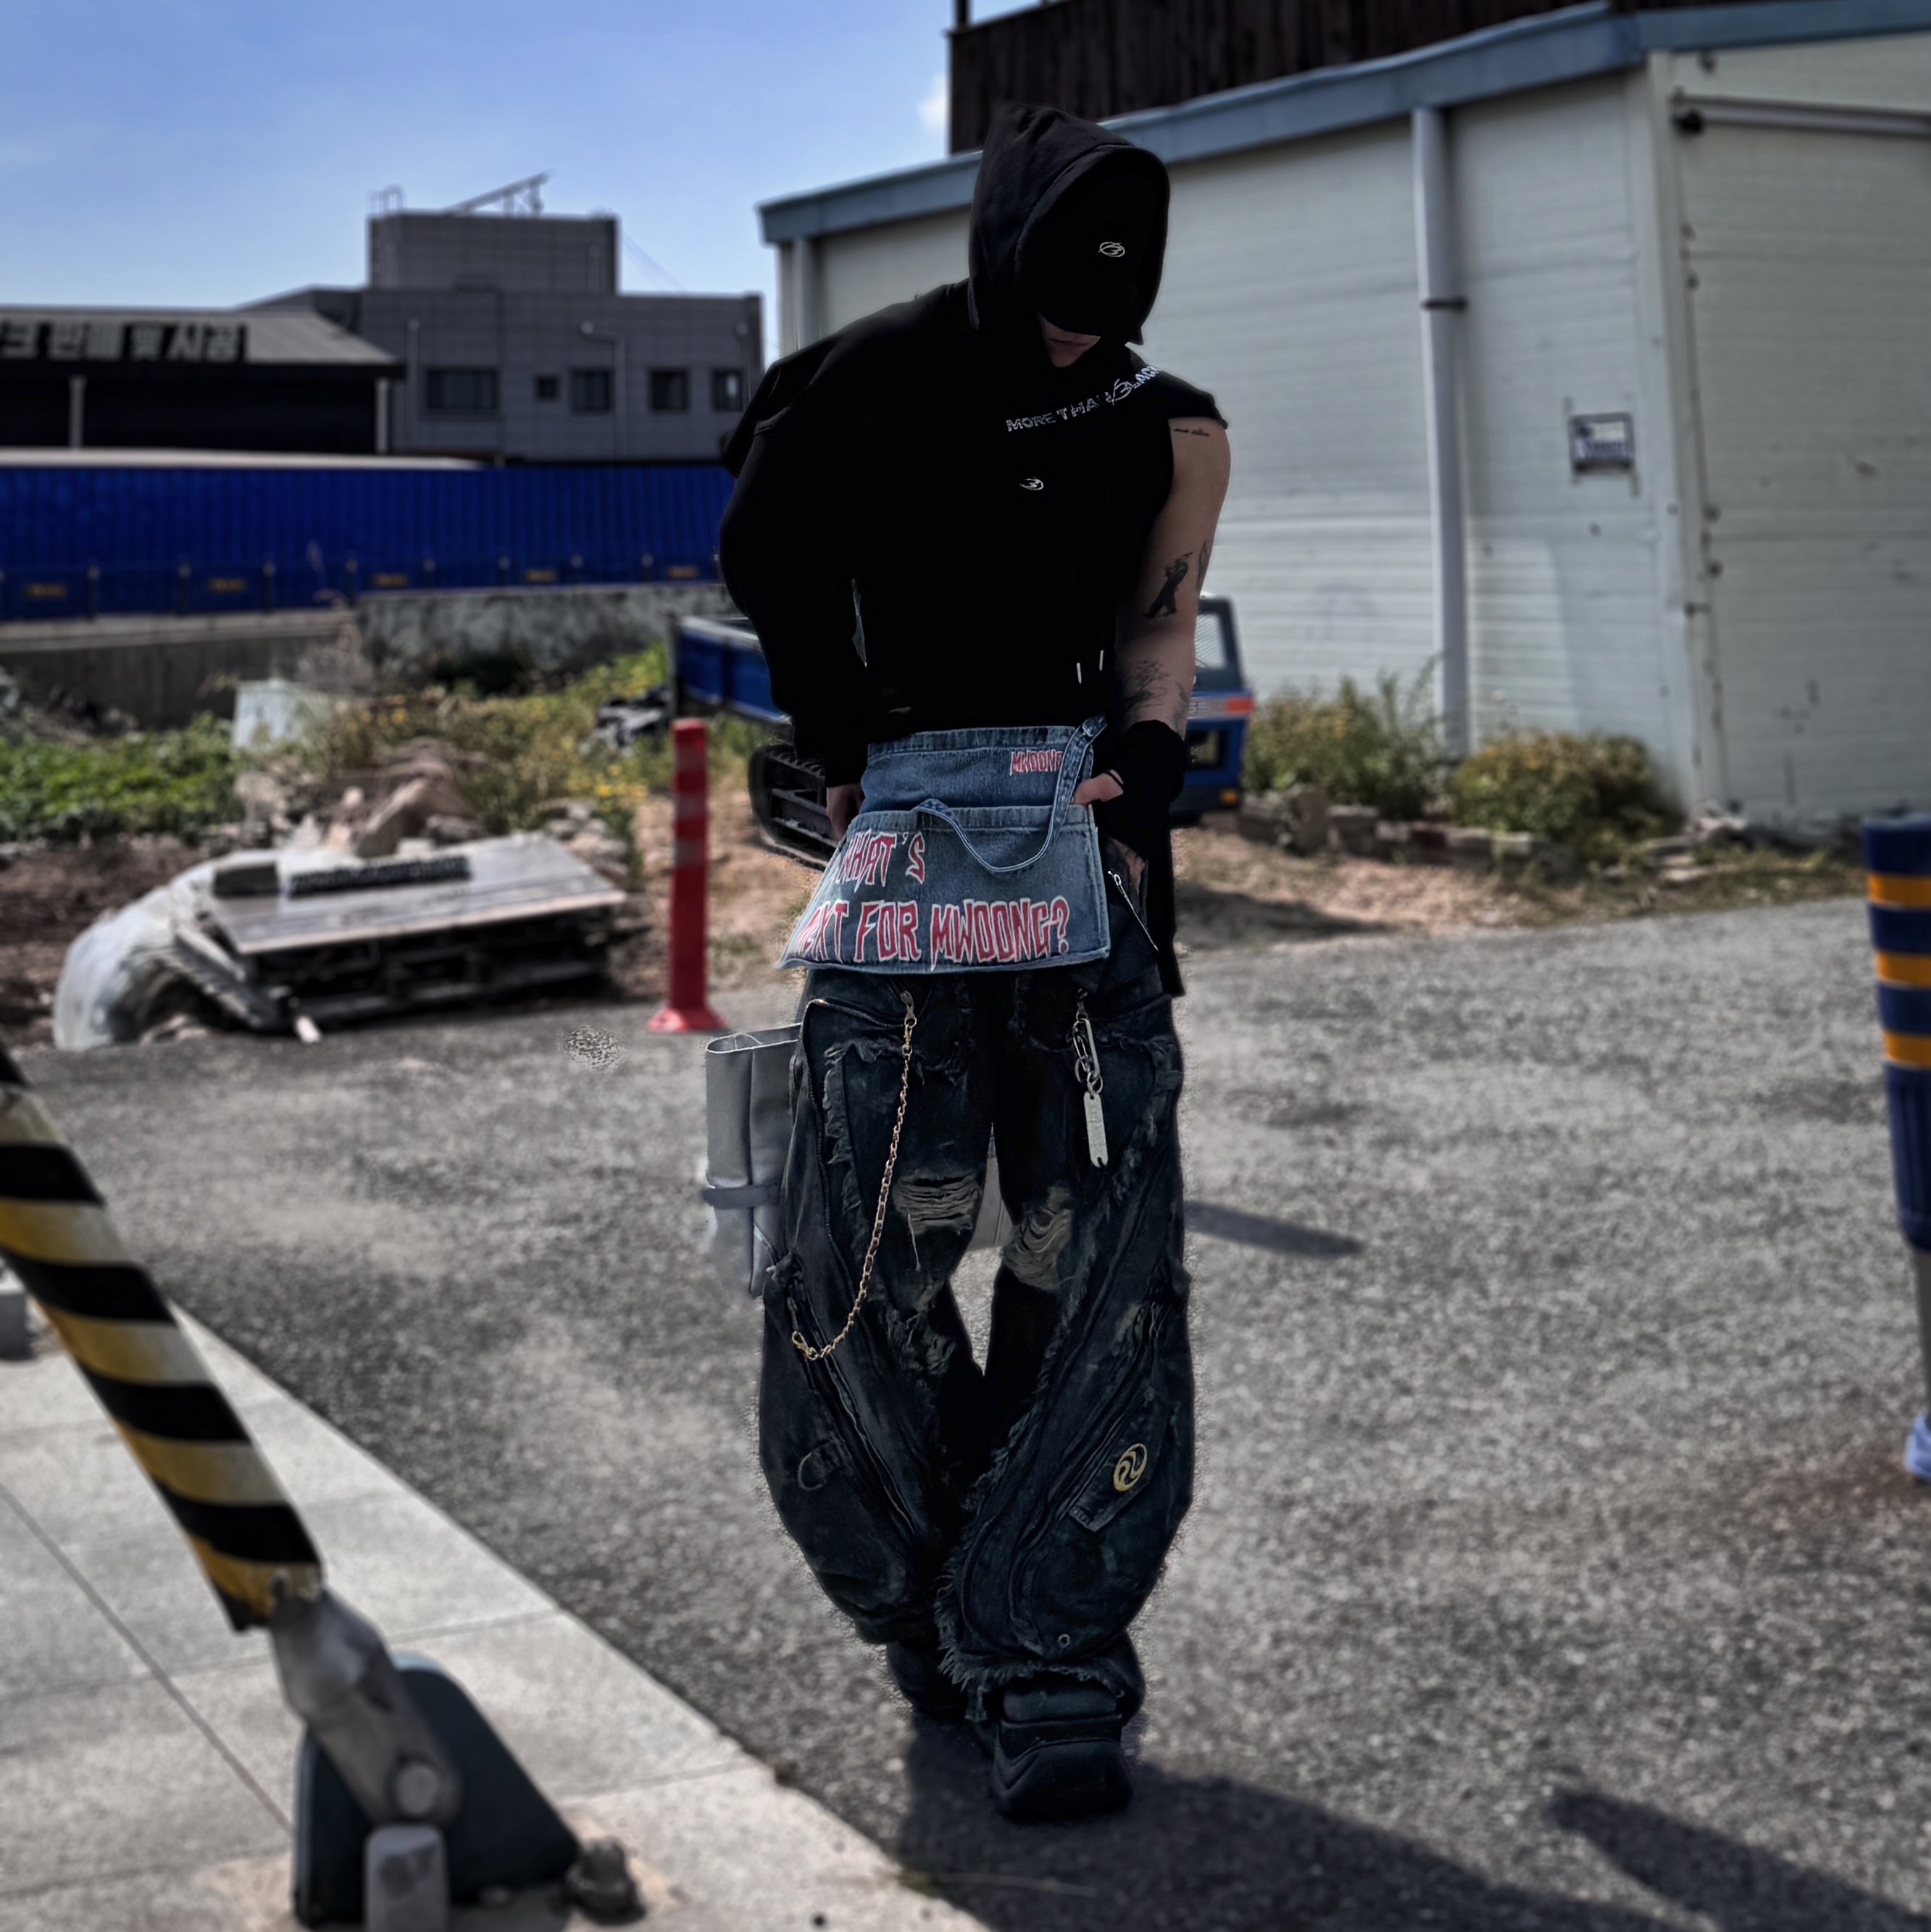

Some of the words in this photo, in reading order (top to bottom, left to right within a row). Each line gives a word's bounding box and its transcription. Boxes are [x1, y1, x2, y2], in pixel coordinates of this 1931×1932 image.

[1006, 412, 1056, 432] MORE
[797, 899, 849, 963] EXT
[854, 900, 922, 963] FOR
[930, 895, 1069, 971] MWOONG?
